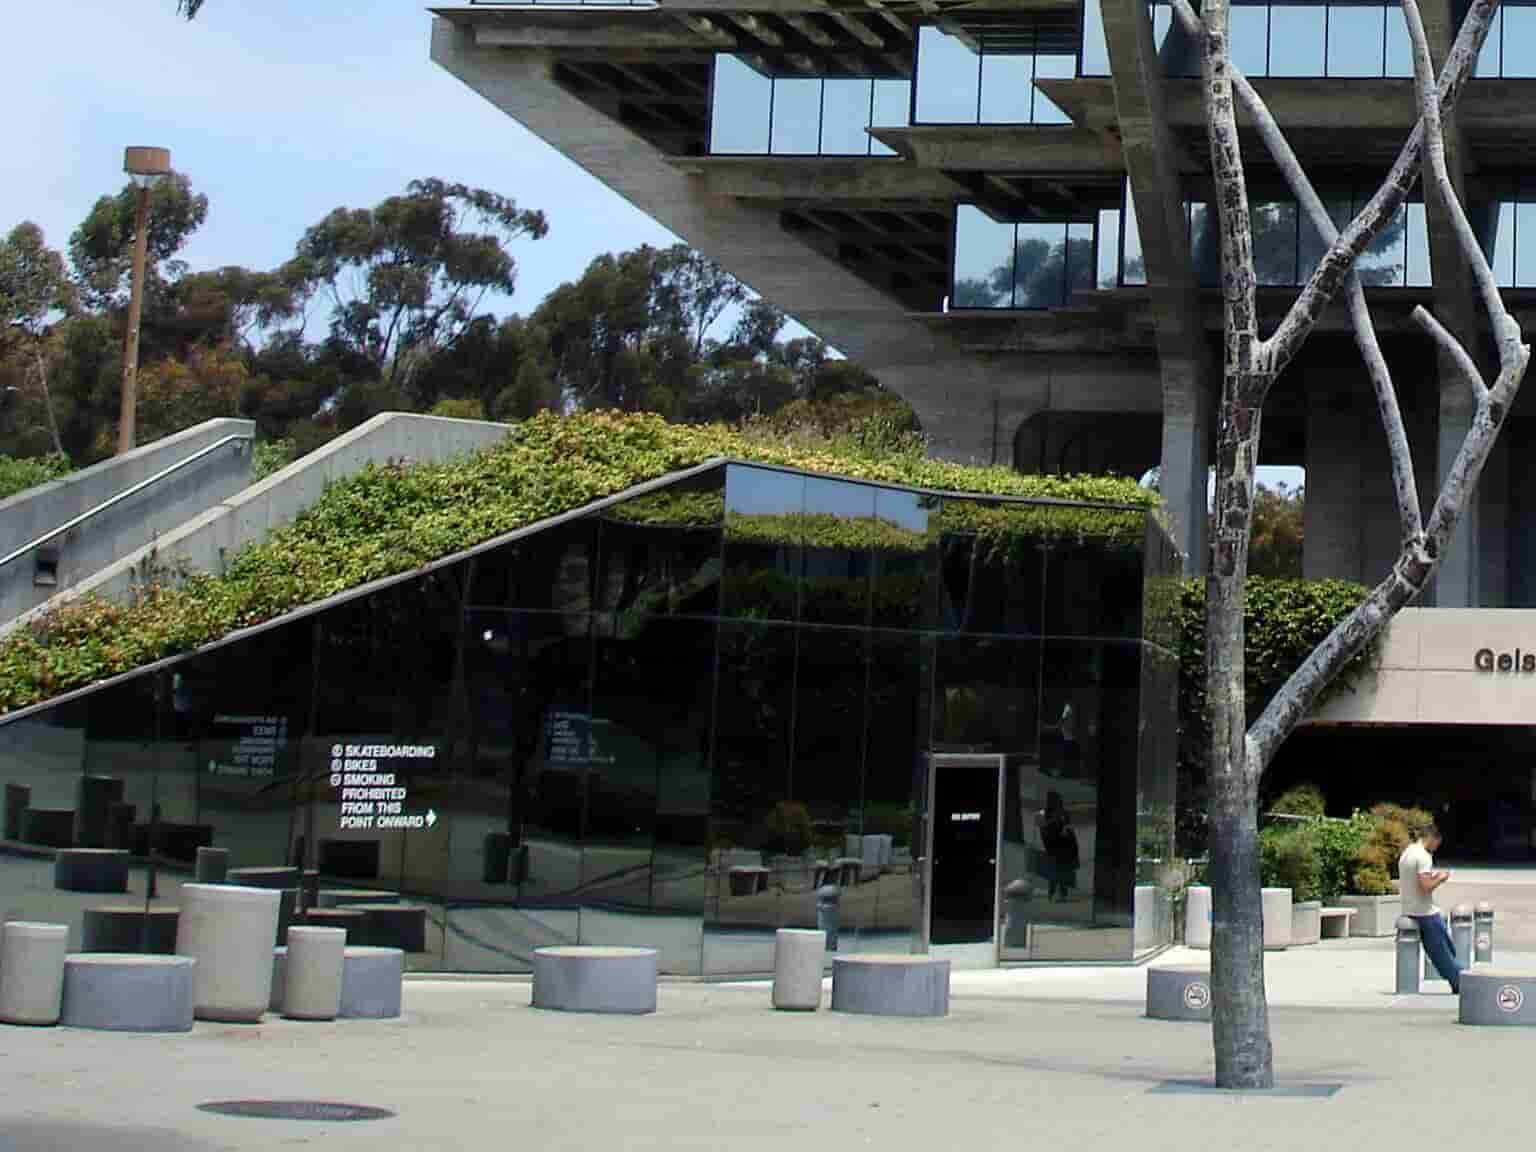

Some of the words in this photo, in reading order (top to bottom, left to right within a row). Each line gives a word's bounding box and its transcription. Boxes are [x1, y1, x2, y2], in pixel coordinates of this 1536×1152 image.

[345, 744, 435, 758] SKATEBOARDING
[343, 759, 378, 771] BIKES
[343, 773, 395, 786] SMOKING
[342, 787, 407, 800] PROHIBITED
[341, 802, 374, 814] FROM
[376, 802, 402, 814] THIS
[340, 815, 375, 828] POINT
[376, 815, 424, 828] ONWARD
